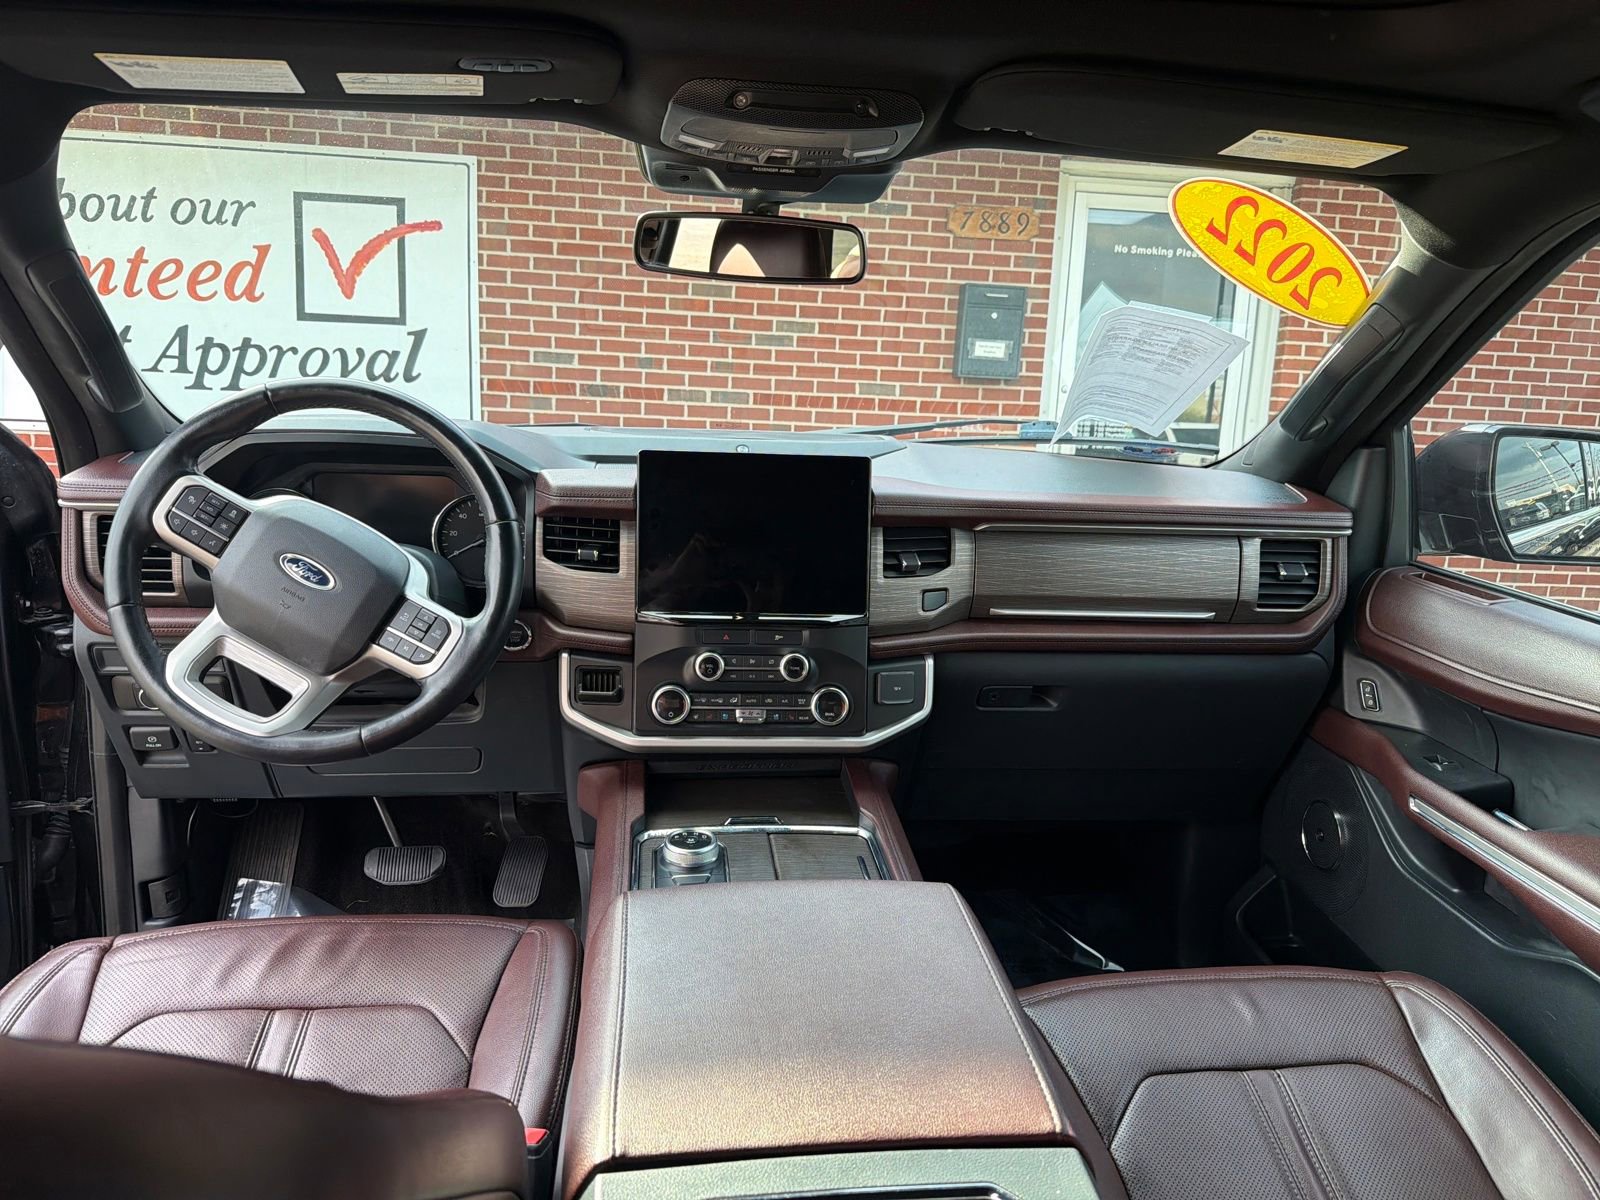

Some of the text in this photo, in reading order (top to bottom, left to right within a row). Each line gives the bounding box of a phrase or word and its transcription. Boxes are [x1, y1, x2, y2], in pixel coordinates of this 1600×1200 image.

[170, 197, 257, 227] our
[959, 210, 1031, 236] 7889
[1114, 244, 1201, 258] No Smoking Plea
[141, 324, 429, 391] Approval
[291, 561, 322, 582] Ford
